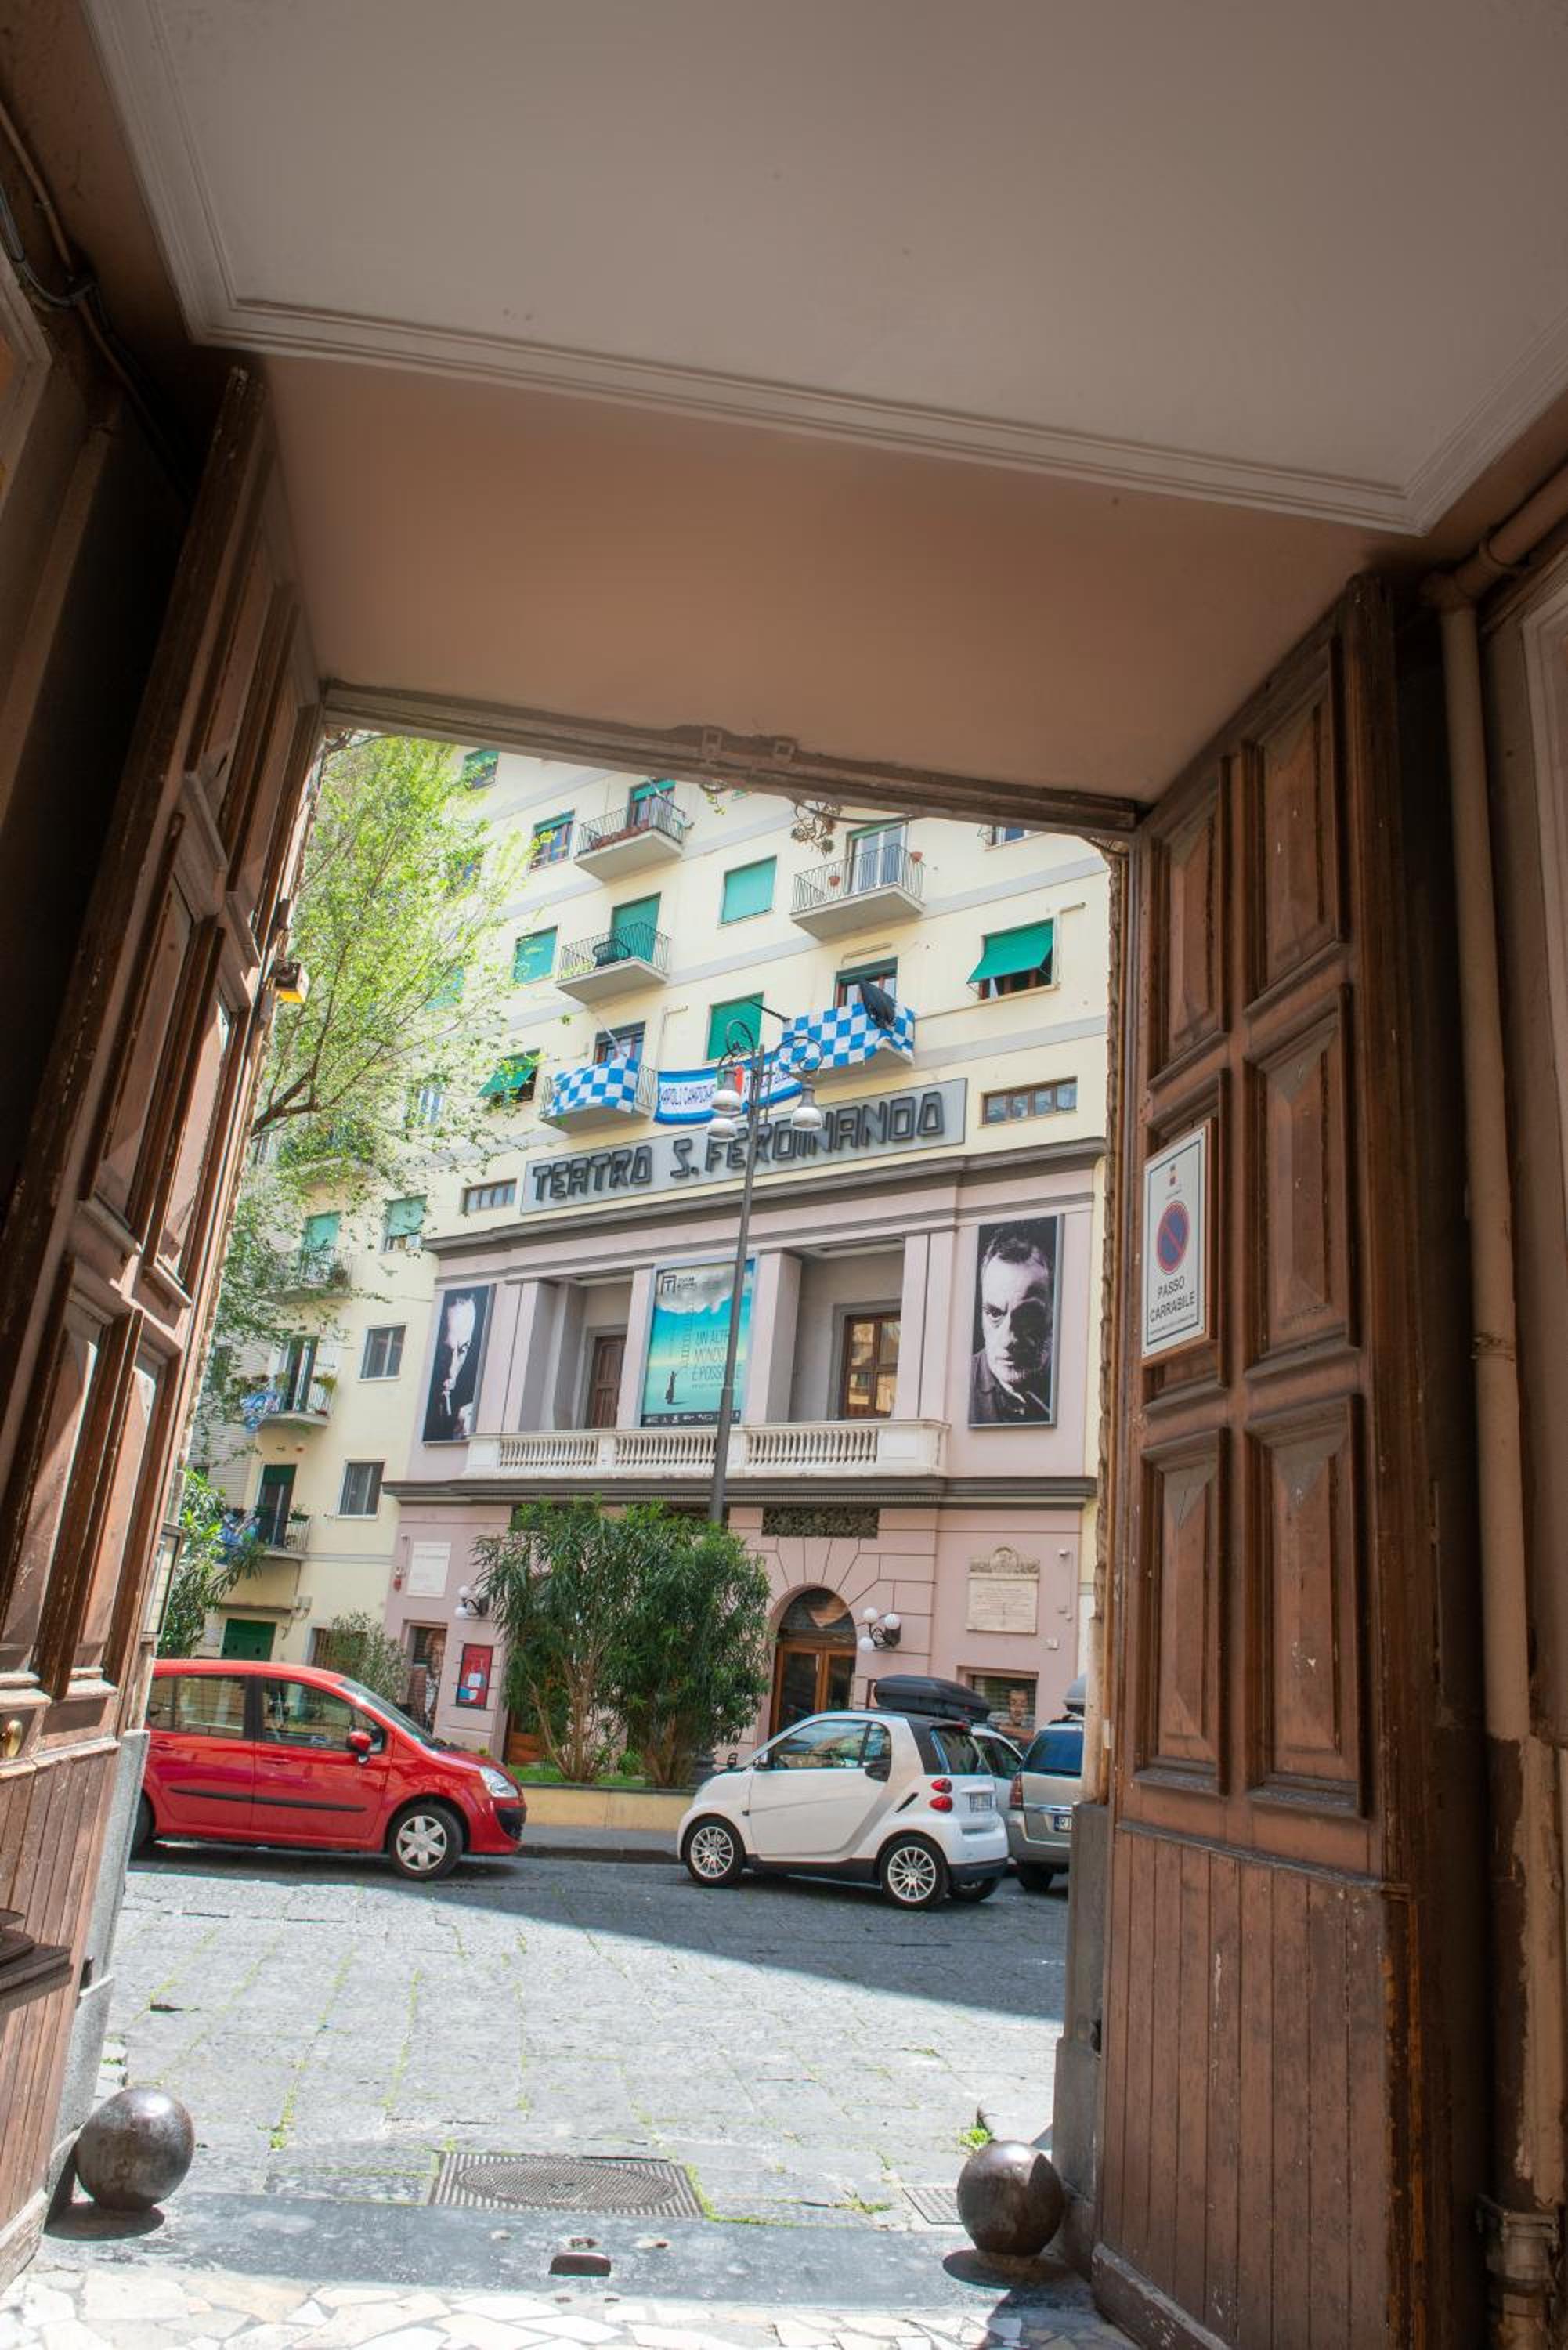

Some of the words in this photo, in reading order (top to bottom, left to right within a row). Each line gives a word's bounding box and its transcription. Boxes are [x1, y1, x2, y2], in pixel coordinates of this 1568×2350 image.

[532, 1145, 652, 1201] TEATRO
[705, 1090, 945, 1172] FERDINANDO
[1157, 1275, 1185, 1300] PASSO
[1149, 1290, 1195, 1323] CARRABILE
